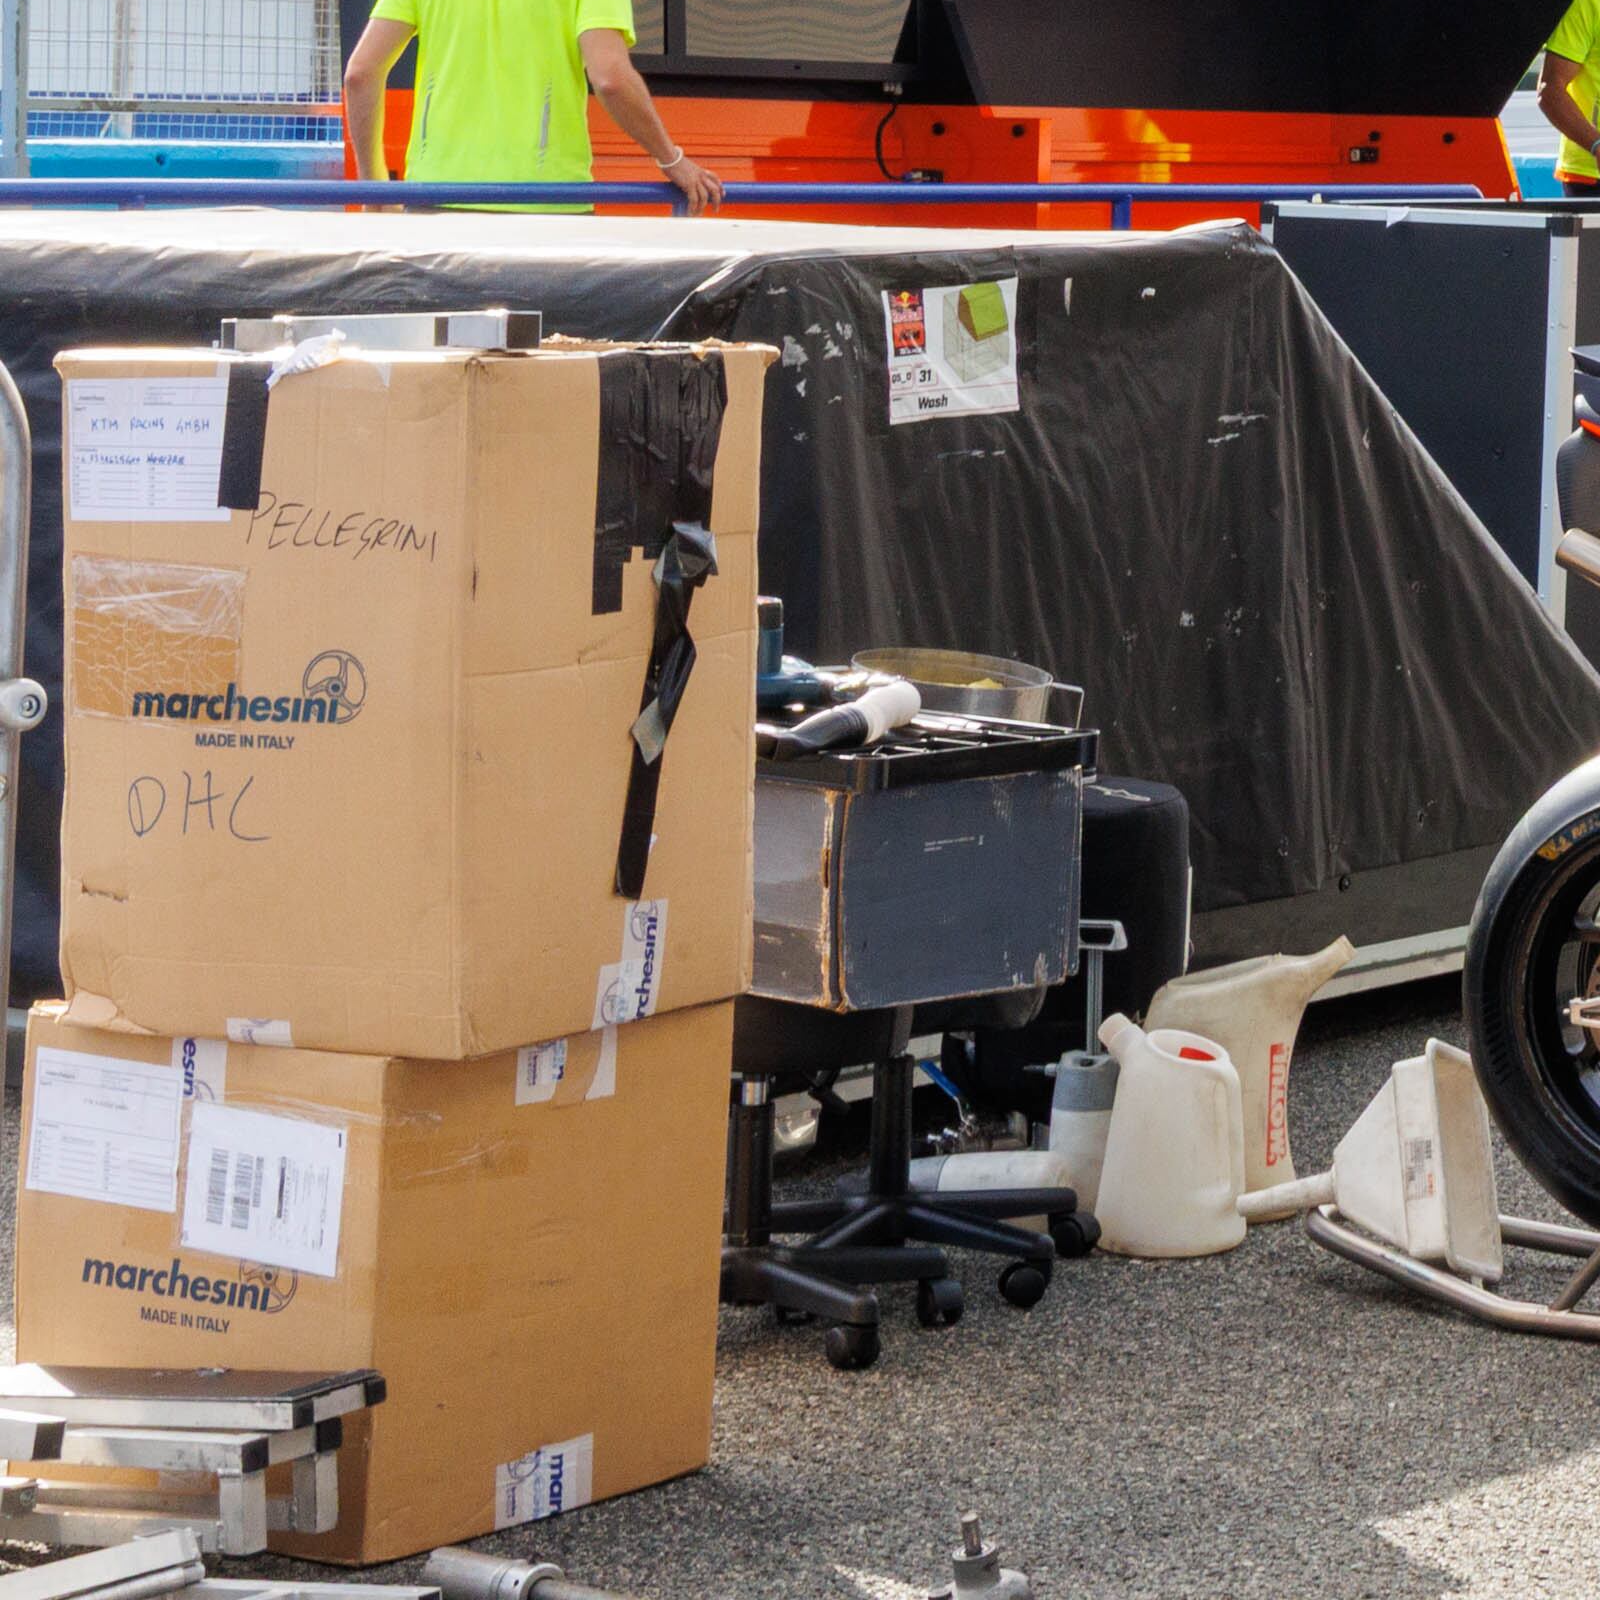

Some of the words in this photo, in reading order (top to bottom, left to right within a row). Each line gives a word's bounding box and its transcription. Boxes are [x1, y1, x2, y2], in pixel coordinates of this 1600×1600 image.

[919, 369, 932, 383] 31
[917, 394, 949, 410] Wash
[91, 417, 119, 432] KTM
[130, 416, 165, 432] RACING
[241, 490, 439, 562] PELLEGRINI
[131, 680, 340, 726] marchesini
[194, 732, 237, 750] MADE
[239, 733, 254, 750] IN
[256, 733, 295, 750] ITALY
[1266, 1043, 1289, 1166] MOTUL
[81, 1255, 271, 1314] marchesini
[139, 1305, 178, 1327] MADE
[179, 1311, 194, 1328] IN
[195, 1313, 231, 1335] ITALY
